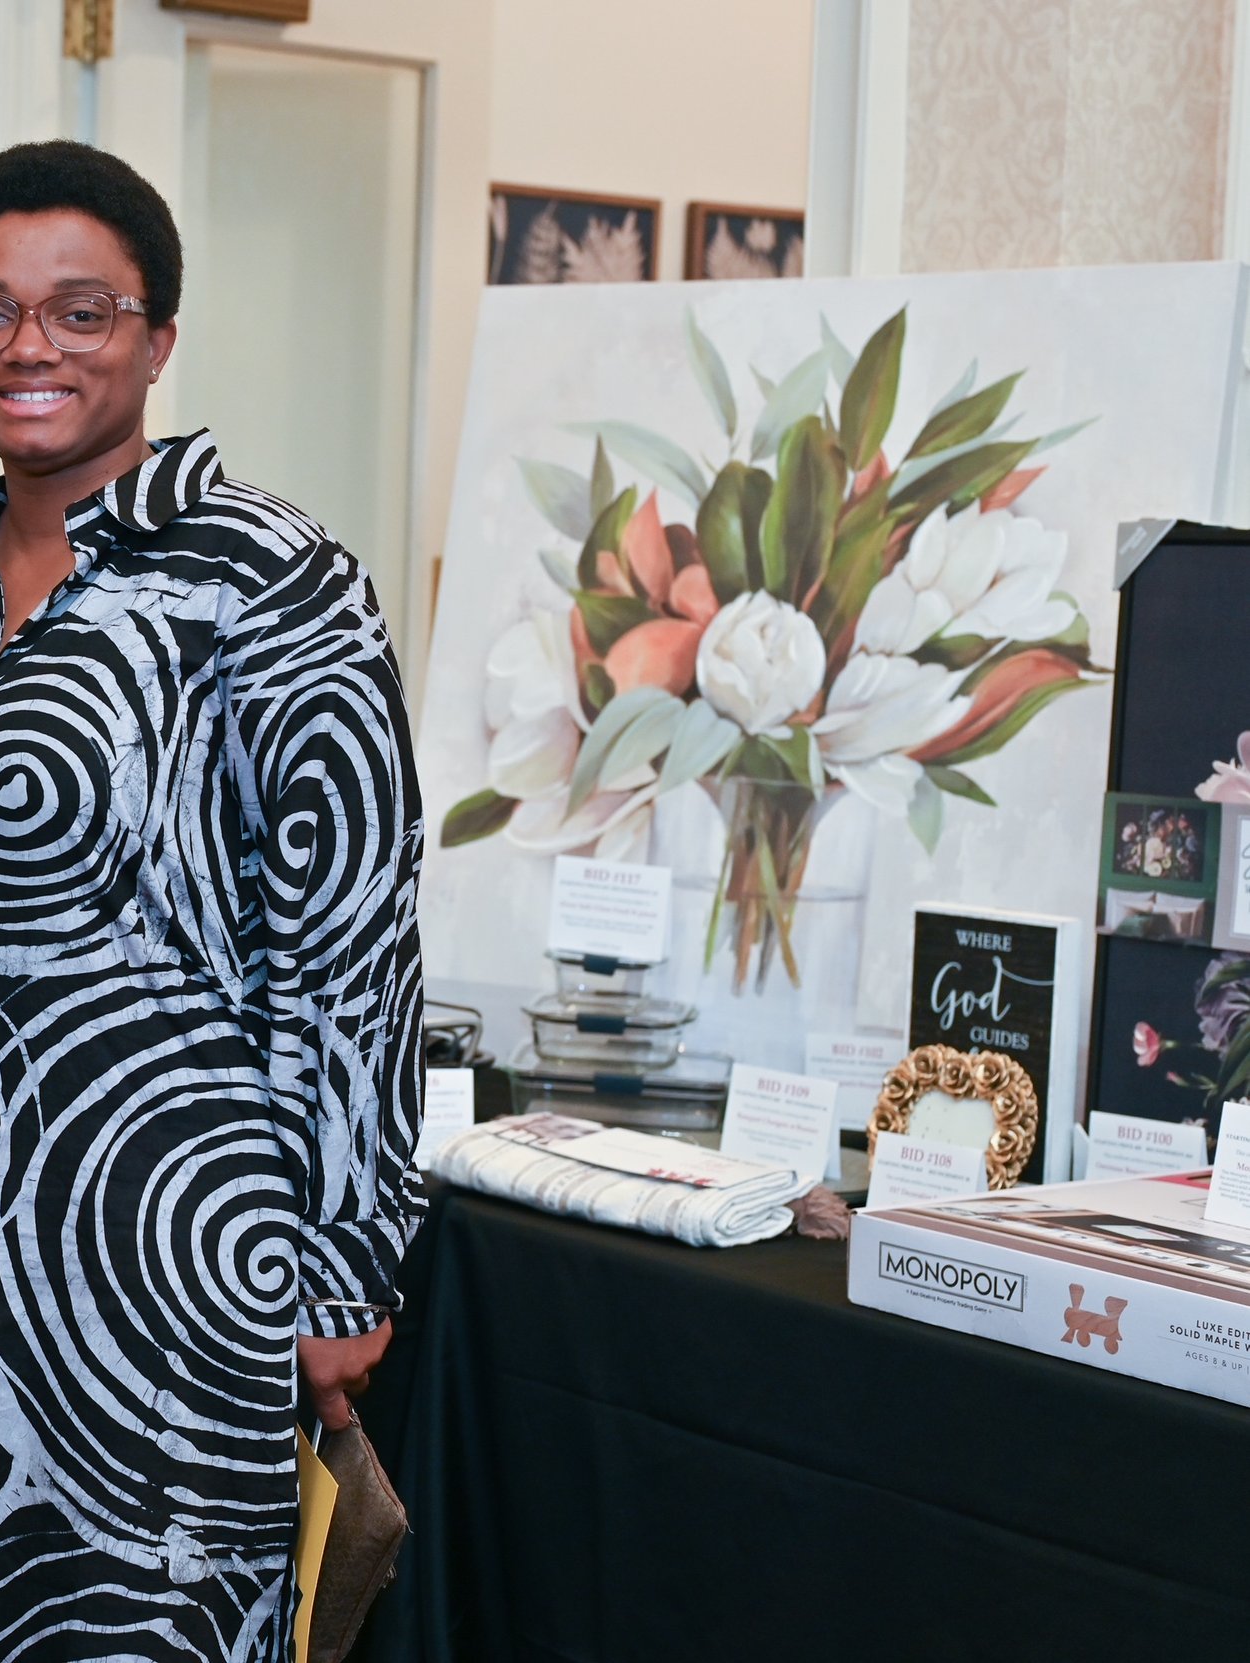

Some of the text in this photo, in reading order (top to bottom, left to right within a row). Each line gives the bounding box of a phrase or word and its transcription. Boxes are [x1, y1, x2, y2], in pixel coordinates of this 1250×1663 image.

[956, 929, 1012, 952] WHERE
[931, 955, 1054, 1031] God
[969, 1026, 1030, 1050] GUIDES
[757, 1078, 781, 1093] BID
[1117, 1125, 1173, 1146] BID #100
[900, 1146, 953, 1168] BID #108
[886, 1252, 1018, 1301] MONOPOLY
[937, 1296, 956, 1307] Property
[957, 1301, 973, 1311] Trading
[1169, 1325, 1200, 1339] SOLID
[1205, 1334, 1240, 1350] MAPLE
[1196, 1320, 1223, 1334] LUXE
[1185, 1350, 1209, 1363] AGES
[1231, 1362, 1243, 1371] UP
